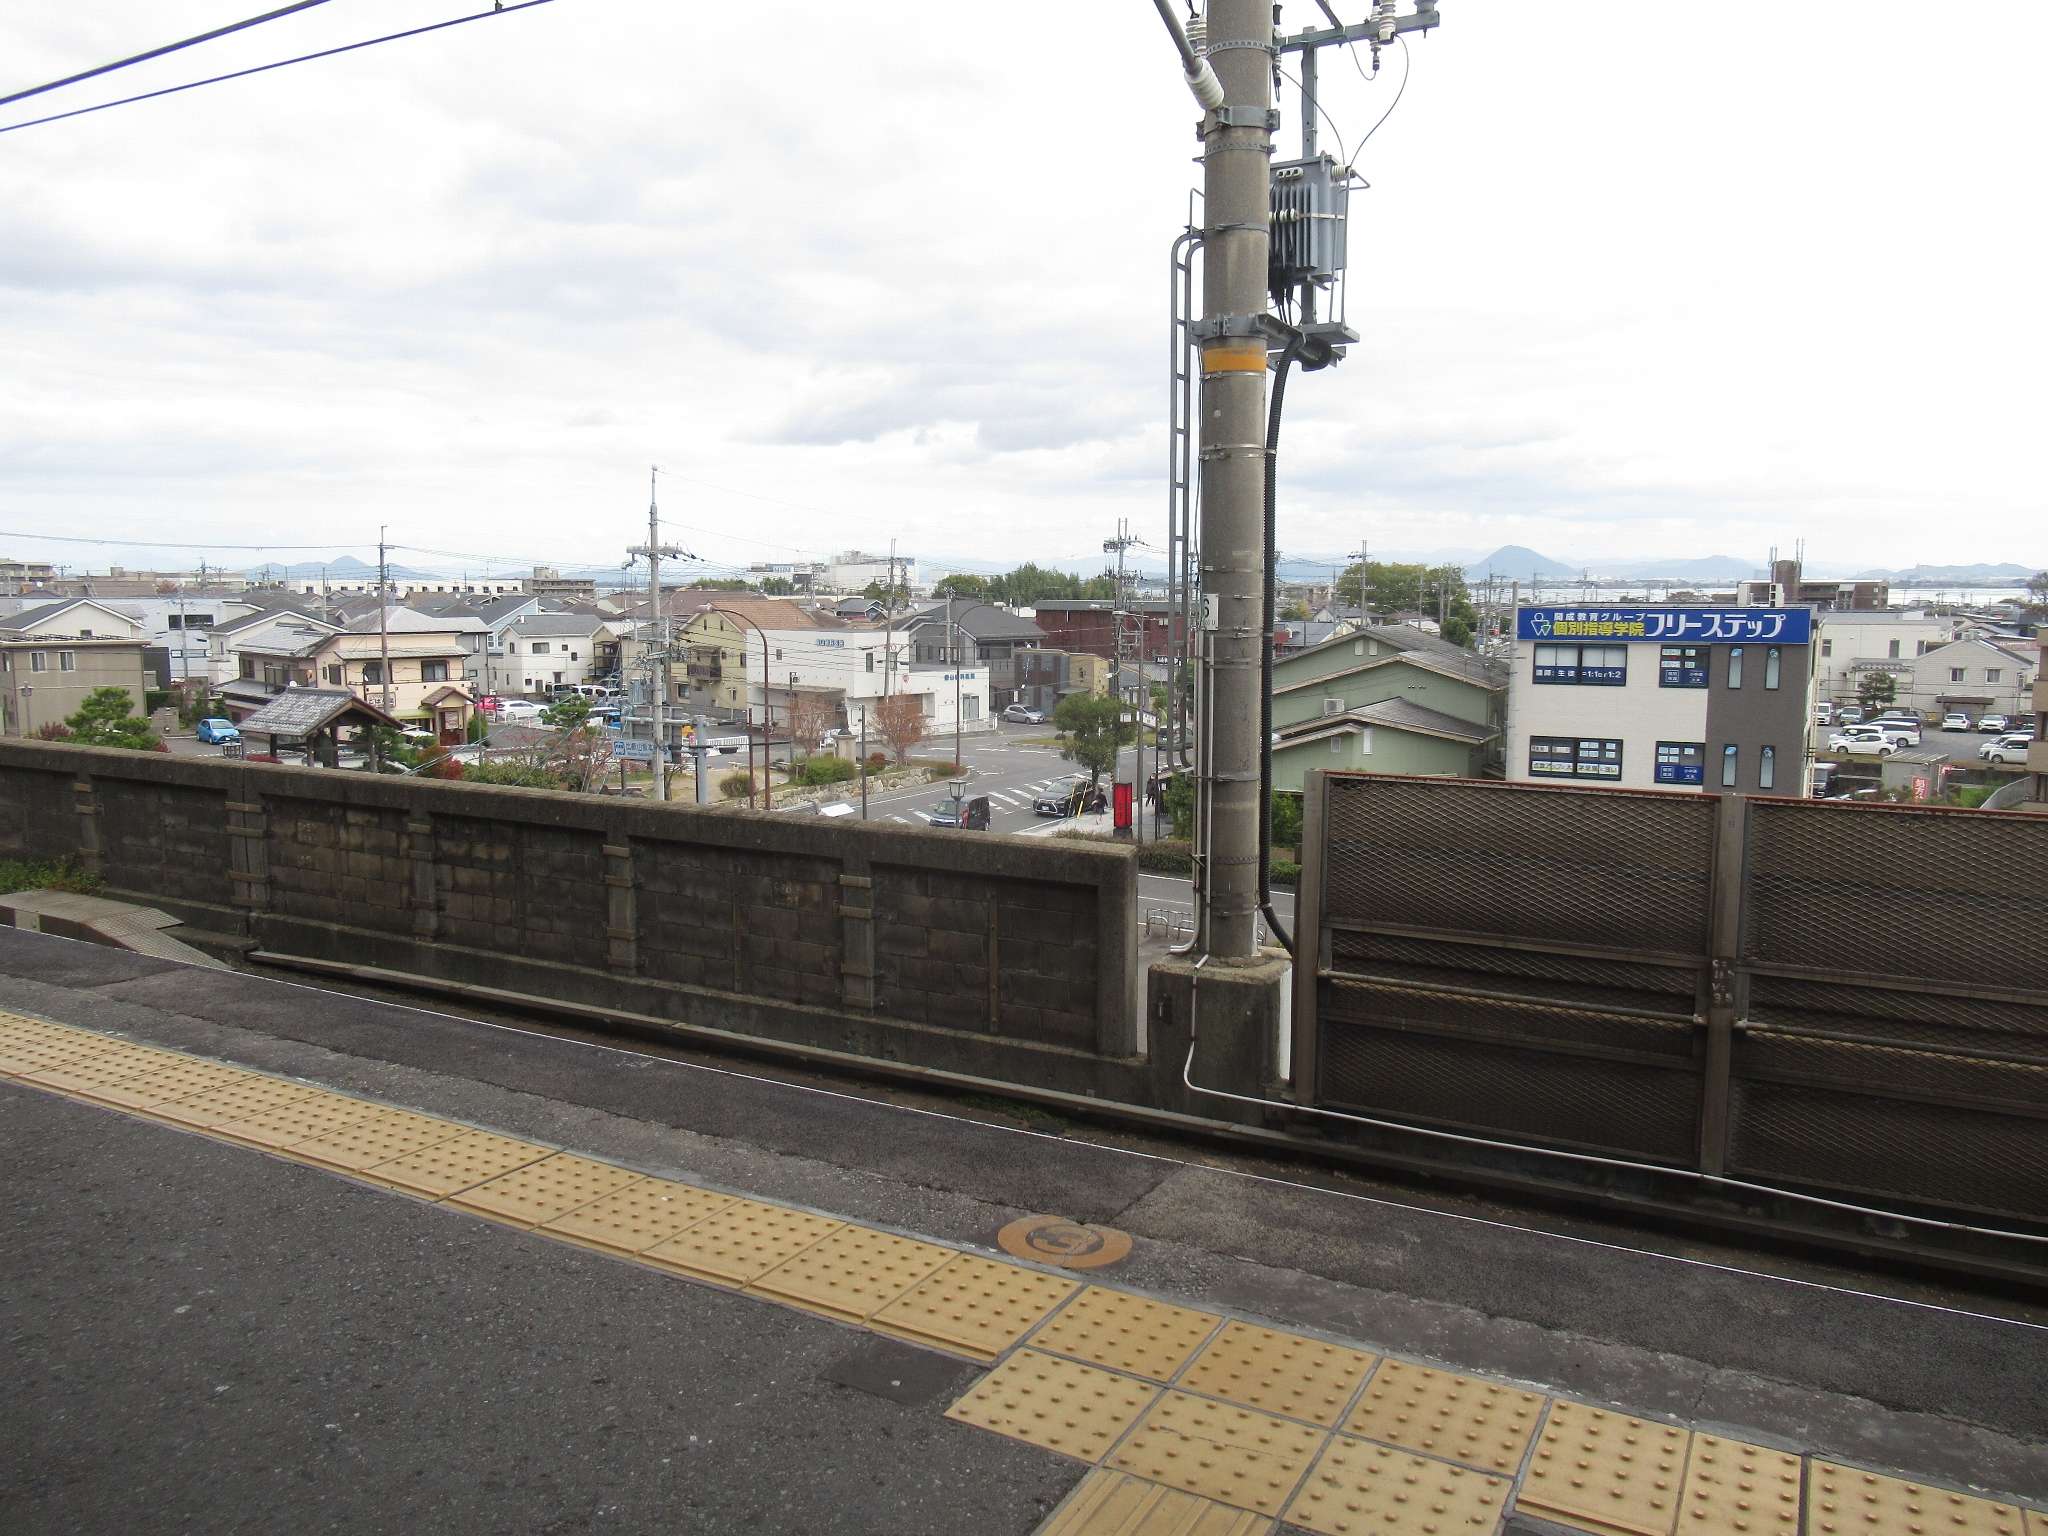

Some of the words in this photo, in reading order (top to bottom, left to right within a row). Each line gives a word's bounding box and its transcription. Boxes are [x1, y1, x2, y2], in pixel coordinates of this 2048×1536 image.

[1552, 621, 1645, 637] 個別指導学院
[1645, 613, 1786, 638] フリーステップ
